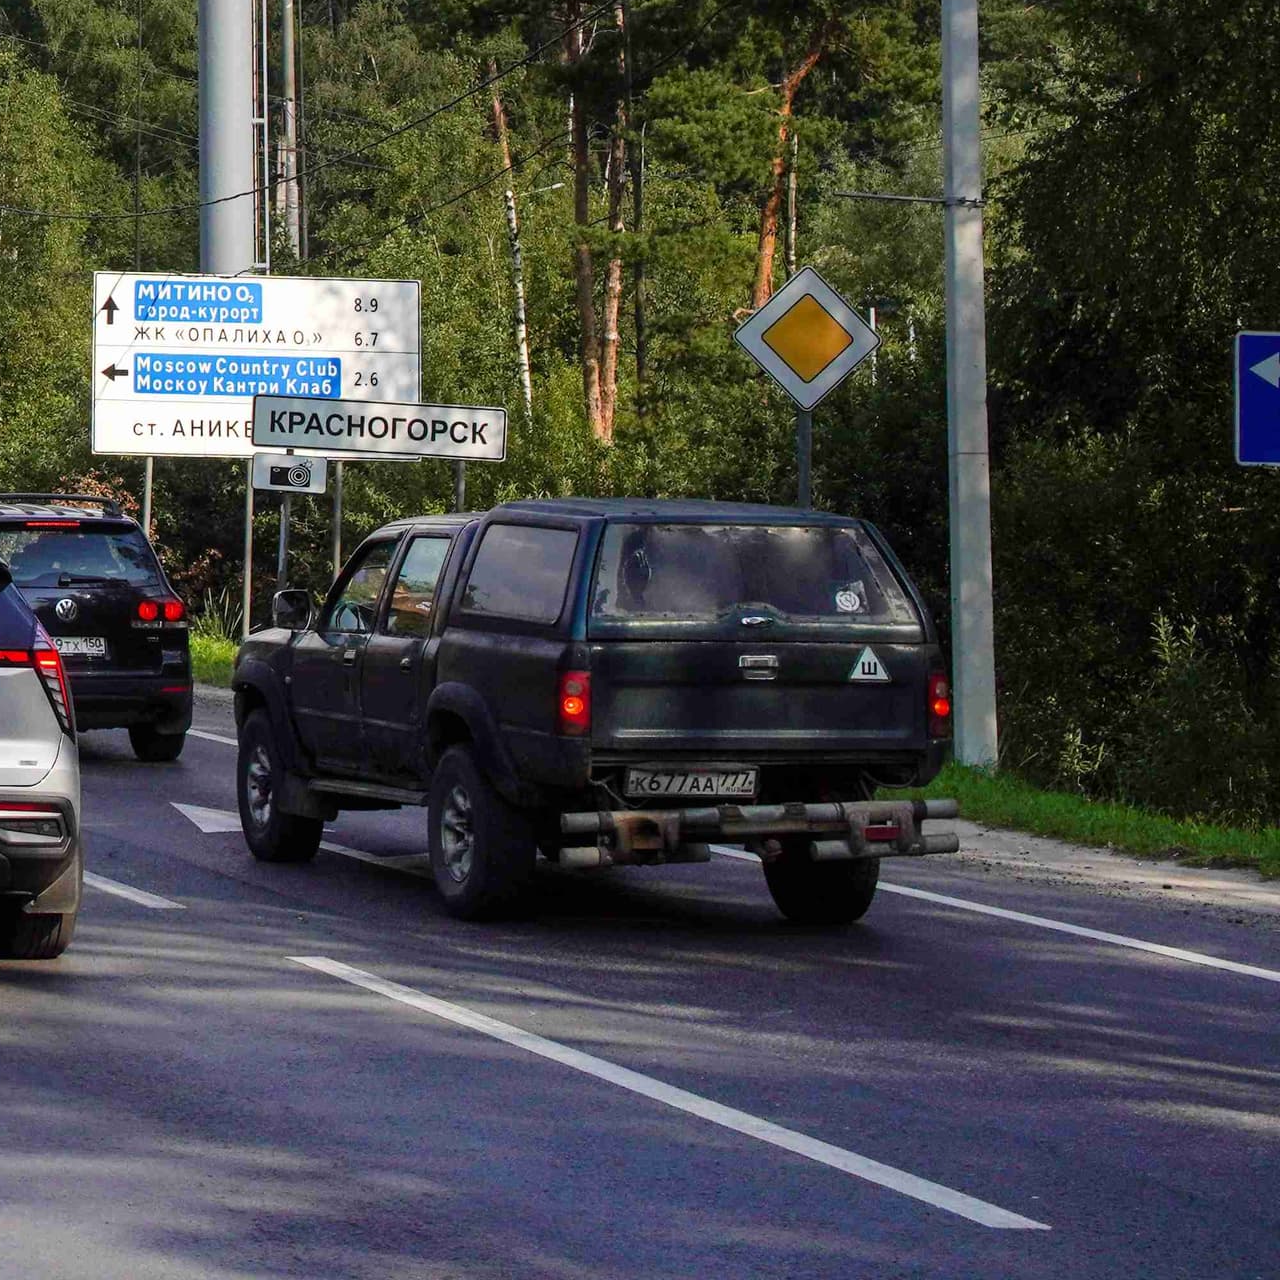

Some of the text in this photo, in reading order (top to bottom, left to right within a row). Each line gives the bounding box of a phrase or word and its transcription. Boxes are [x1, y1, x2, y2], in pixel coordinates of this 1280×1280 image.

[138, 283, 231, 302] МИТИНО
[138, 304, 259, 321] город-курорт
[354, 297, 379, 313] 8.9
[134, 326, 166, 341] ЖК
[175, 327, 286, 344] «ОПАЛИХА
[354, 332, 379, 347] 6.7
[137, 356, 338, 380] Moscow Country Club
[137, 374, 332, 395] Москоу Кантри Клаб
[354, 371, 379, 387] 2.6
[133, 420, 253, 439] ст. АНИКЕ
[270, 410, 489, 445] КРАСНОГОРСК
